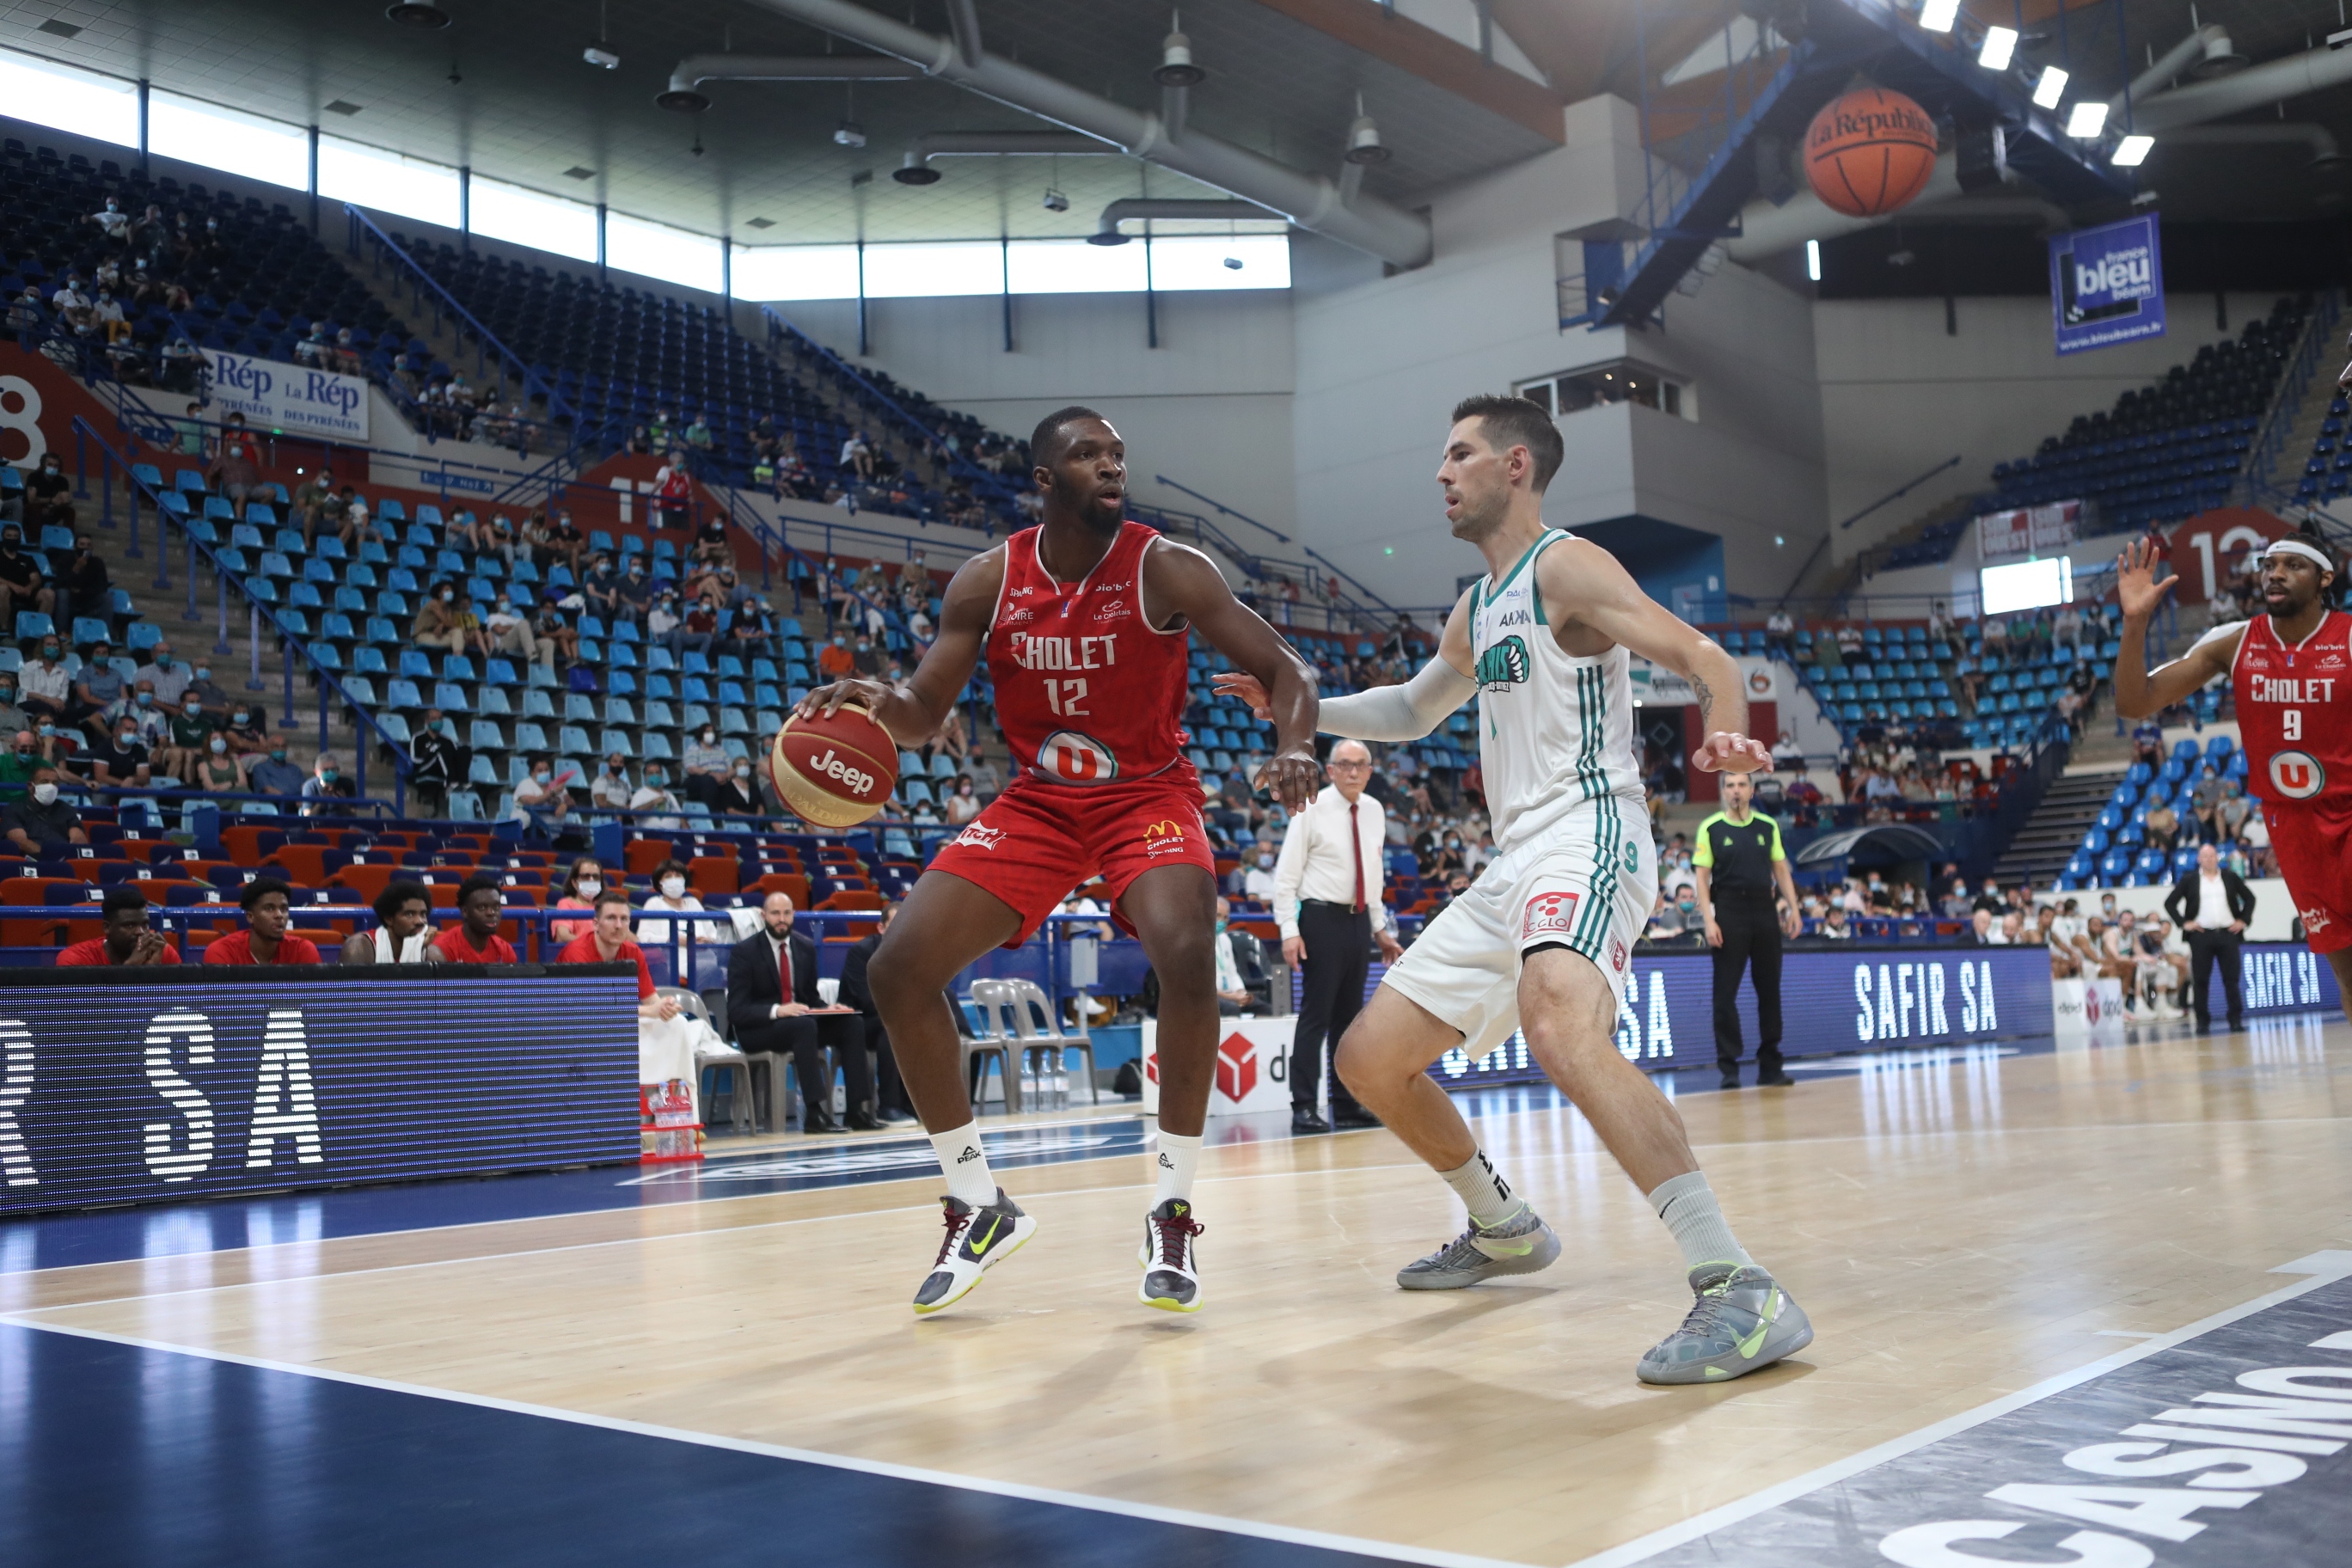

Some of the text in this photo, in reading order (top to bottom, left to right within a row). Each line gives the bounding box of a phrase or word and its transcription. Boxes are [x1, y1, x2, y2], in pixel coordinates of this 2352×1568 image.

[2076, 258, 2151, 296] bleu
[306, 371, 359, 416] Rép
[1011, 631, 1118, 671] CHOLET
[1043, 677, 1090, 717] 12
[2251, 674, 2336, 703] CHOLET
[2282, 709, 2302, 741] 9
[810, 750, 874, 794] Jeep
[2280, 763, 2310, 788] U
[1148, 836, 1185, 850] CHOLET
[1624, 841, 1638, 874] 9
[2244, 951, 2321, 1008] SAFIR SA
[1854, 959, 1997, 1044] SAFIR SA
[141, 1006, 326, 1184] SA
[961, 1150, 981, 1164] PEAK
